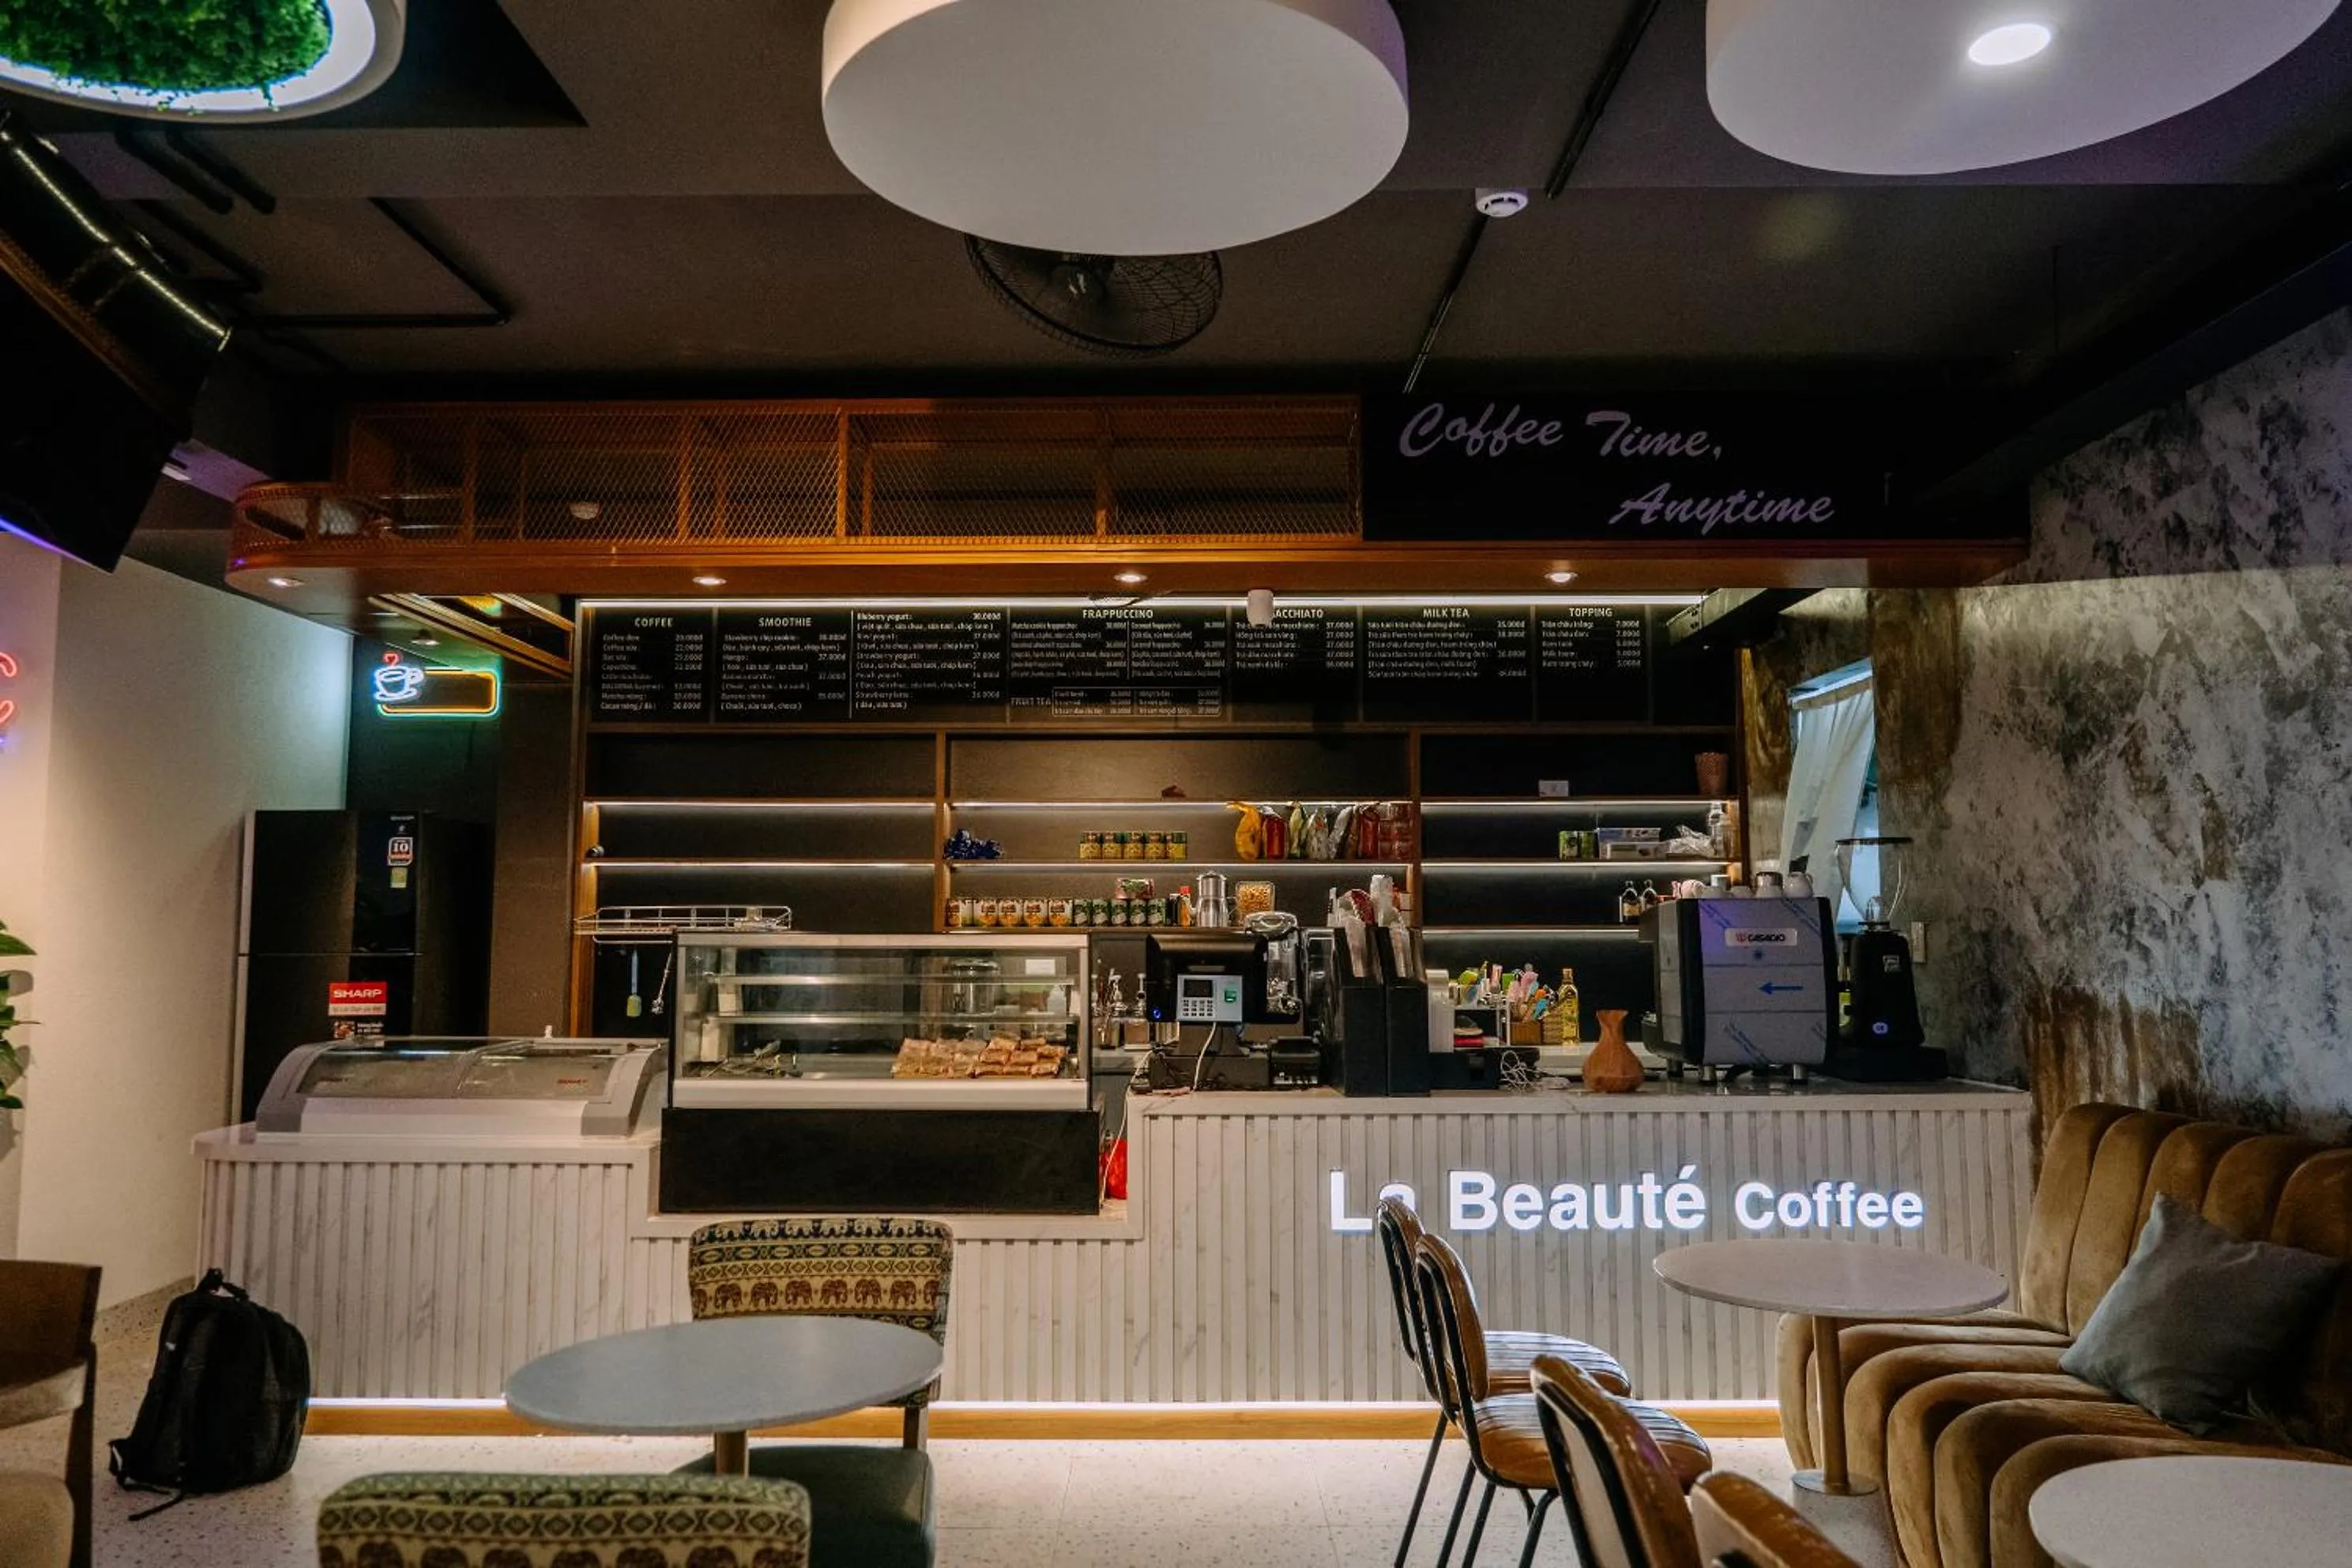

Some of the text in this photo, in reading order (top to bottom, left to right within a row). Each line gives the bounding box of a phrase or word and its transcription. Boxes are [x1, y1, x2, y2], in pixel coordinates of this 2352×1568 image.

[1398, 402, 1722, 460] Coffee Time,
[1609, 483, 1835, 536] Anytime
[1082, 609, 1153, 619] FRAPPUCCINO
[1273, 609, 1324, 619] ACCHIATO
[1423, 608, 1470, 619] MILK TEA
[1569, 607, 1613, 617] TOPPING
[634, 617, 674, 628] COFFEE
[758, 617, 812, 627] SMOOTHIE
[393, 843, 408, 852] 10
[333, 989, 382, 998] SHARP
[1449, 1165, 1707, 1231] Beauté
[1735, 1181, 1924, 1230] Coffee
